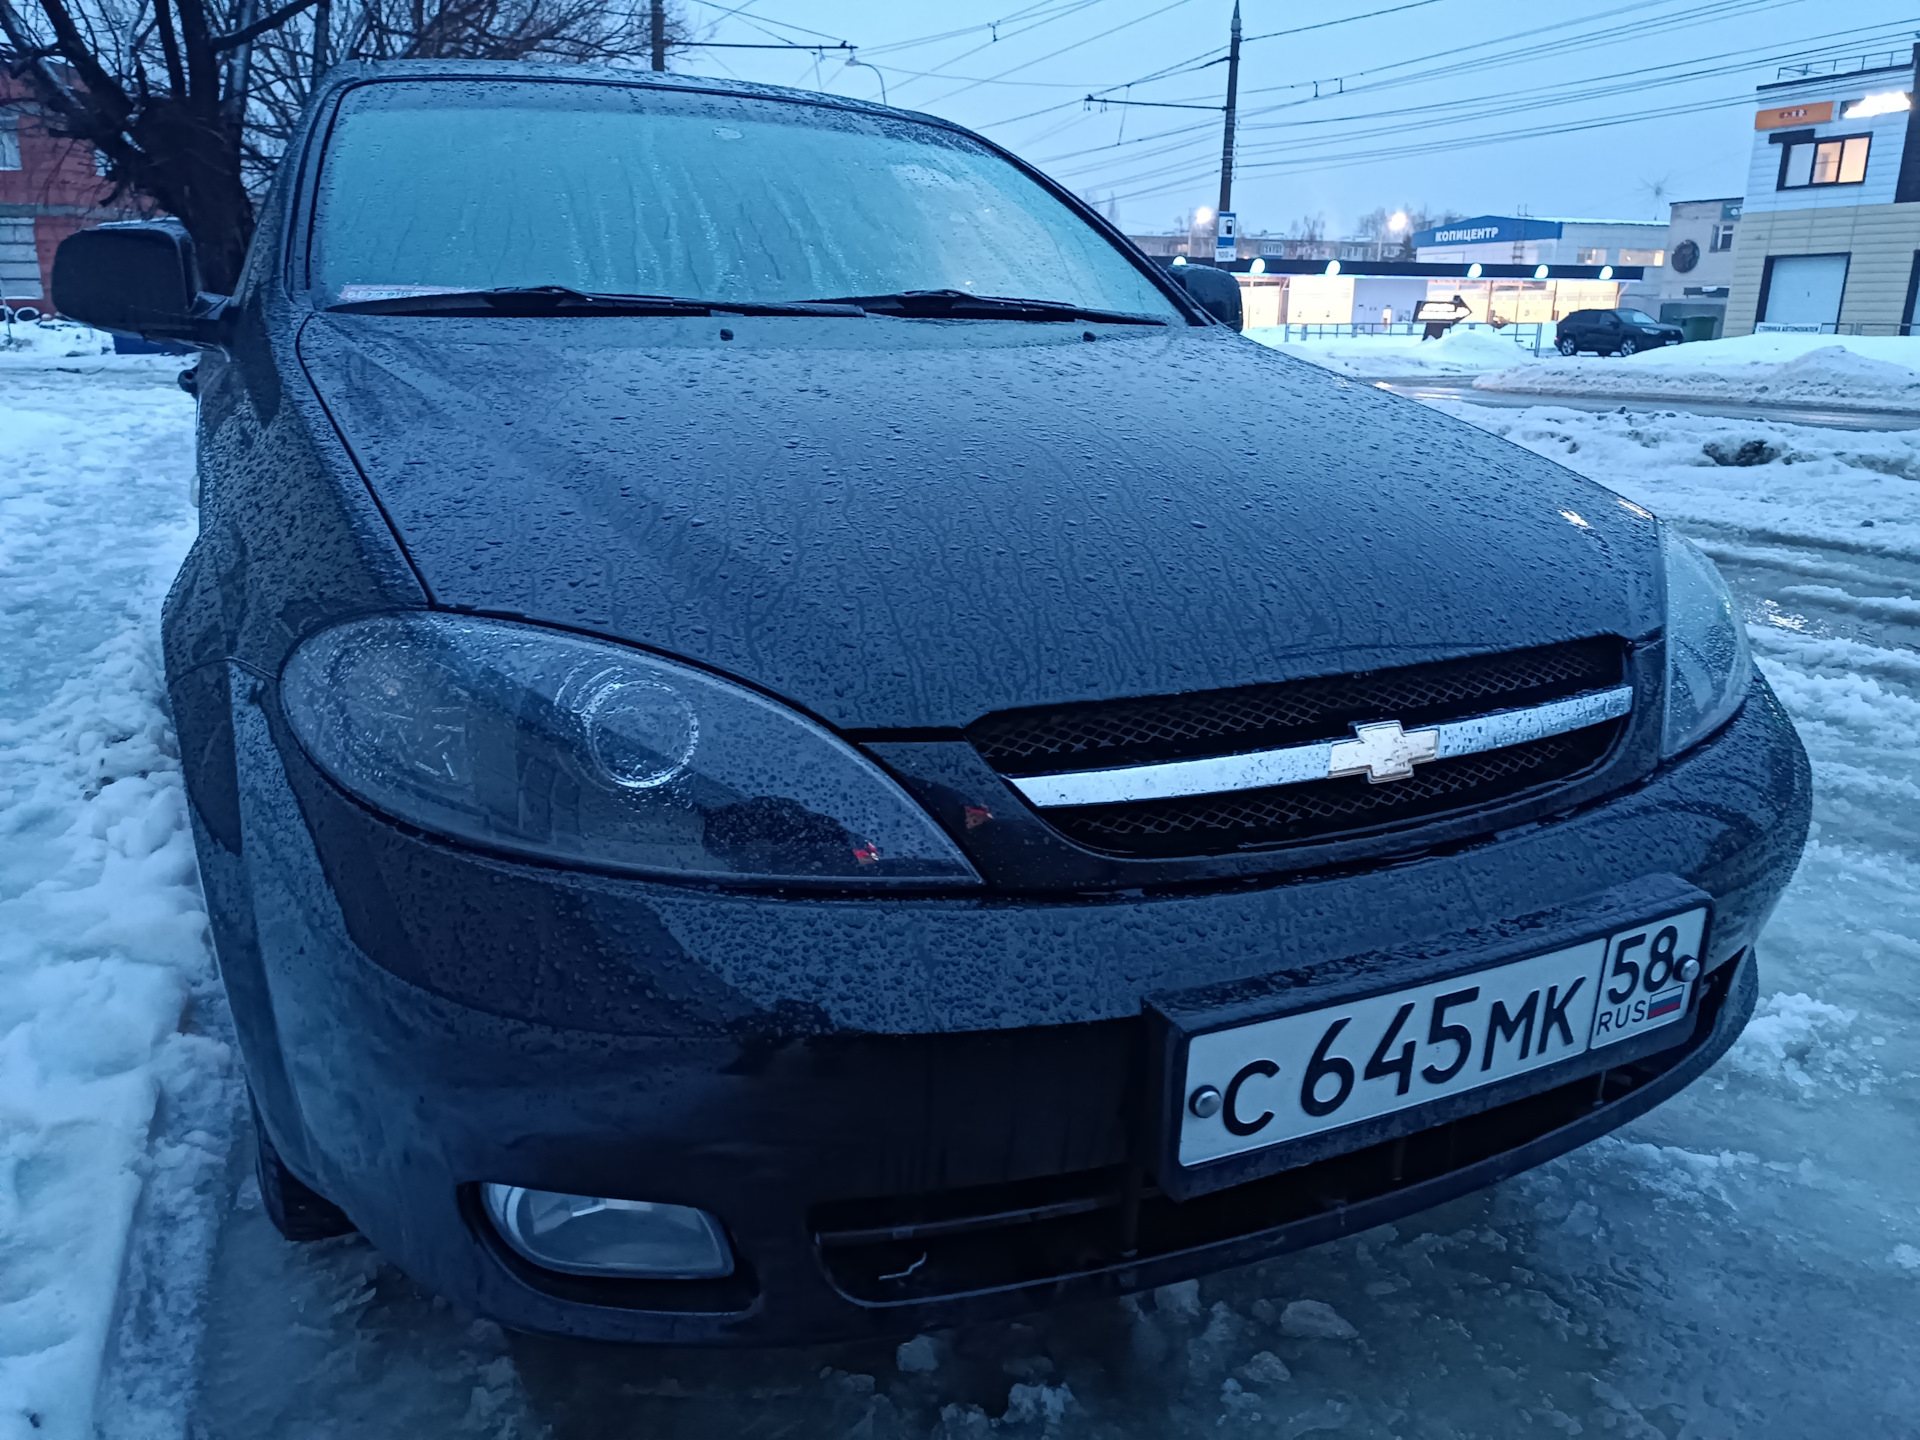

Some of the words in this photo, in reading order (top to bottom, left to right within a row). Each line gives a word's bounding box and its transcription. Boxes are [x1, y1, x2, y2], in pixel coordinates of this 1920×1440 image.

[1434, 226, 1499, 243] КОПИЦЕНТР
[1608, 925, 1678, 1005] 58
[1596, 1000, 1646, 1036] RUS
